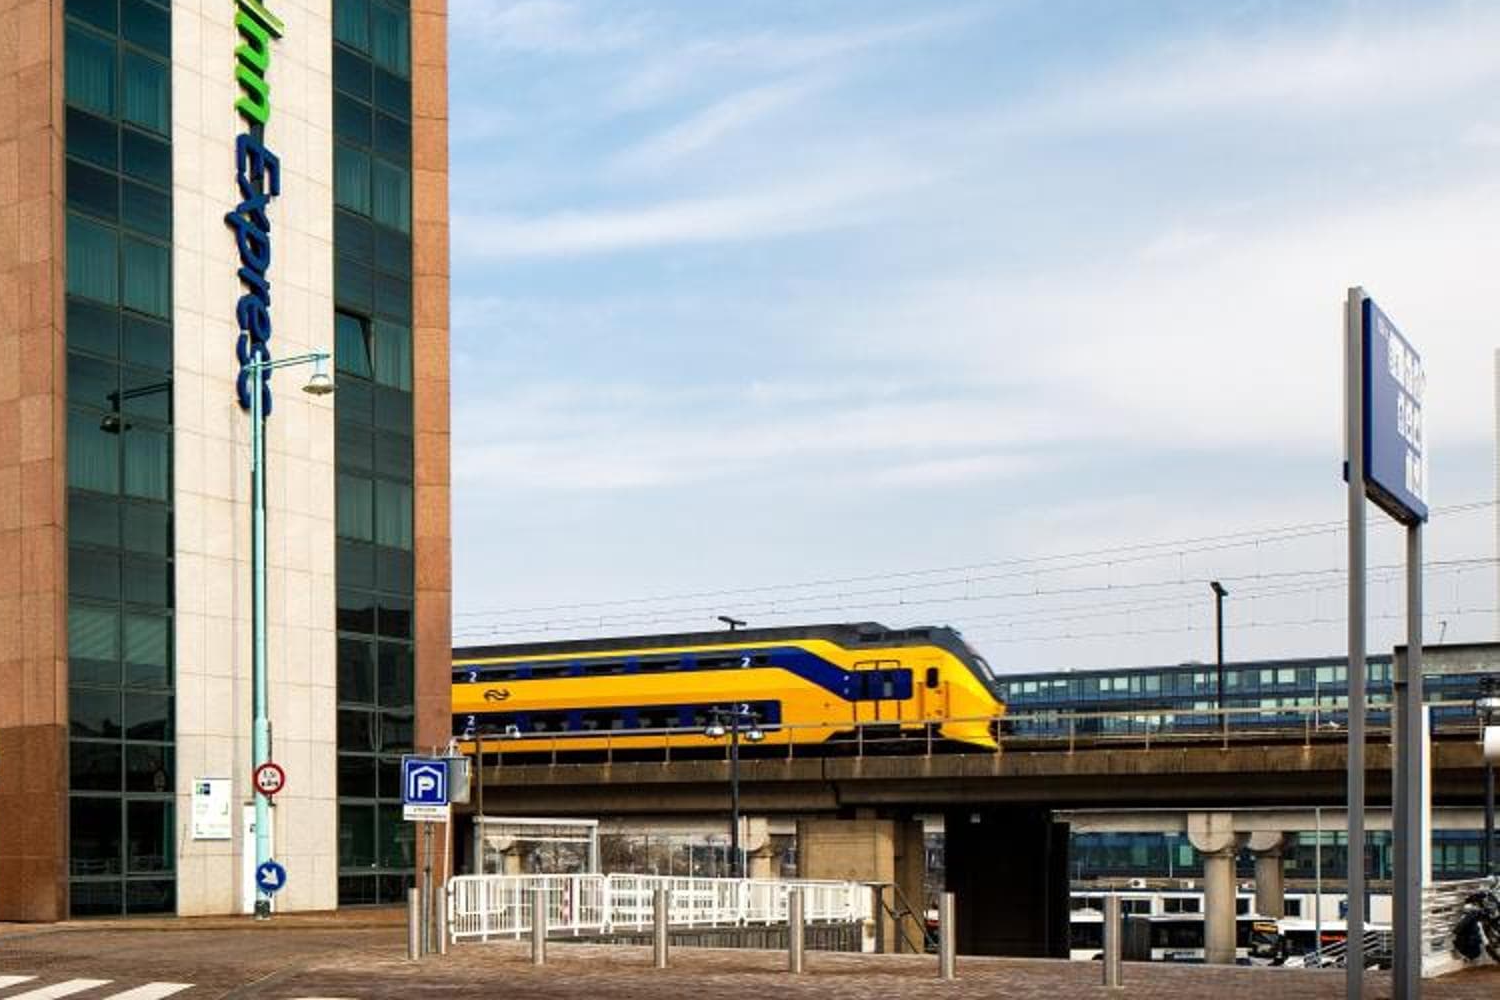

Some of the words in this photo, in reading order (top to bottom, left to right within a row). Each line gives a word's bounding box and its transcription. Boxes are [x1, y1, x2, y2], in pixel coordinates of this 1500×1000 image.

[224, 132, 282, 417] Express
[741, 657, 750, 668] 2
[468, 671, 477, 683] 2
[741, 703, 749, 715] 2
[417, 775, 435, 799] P
